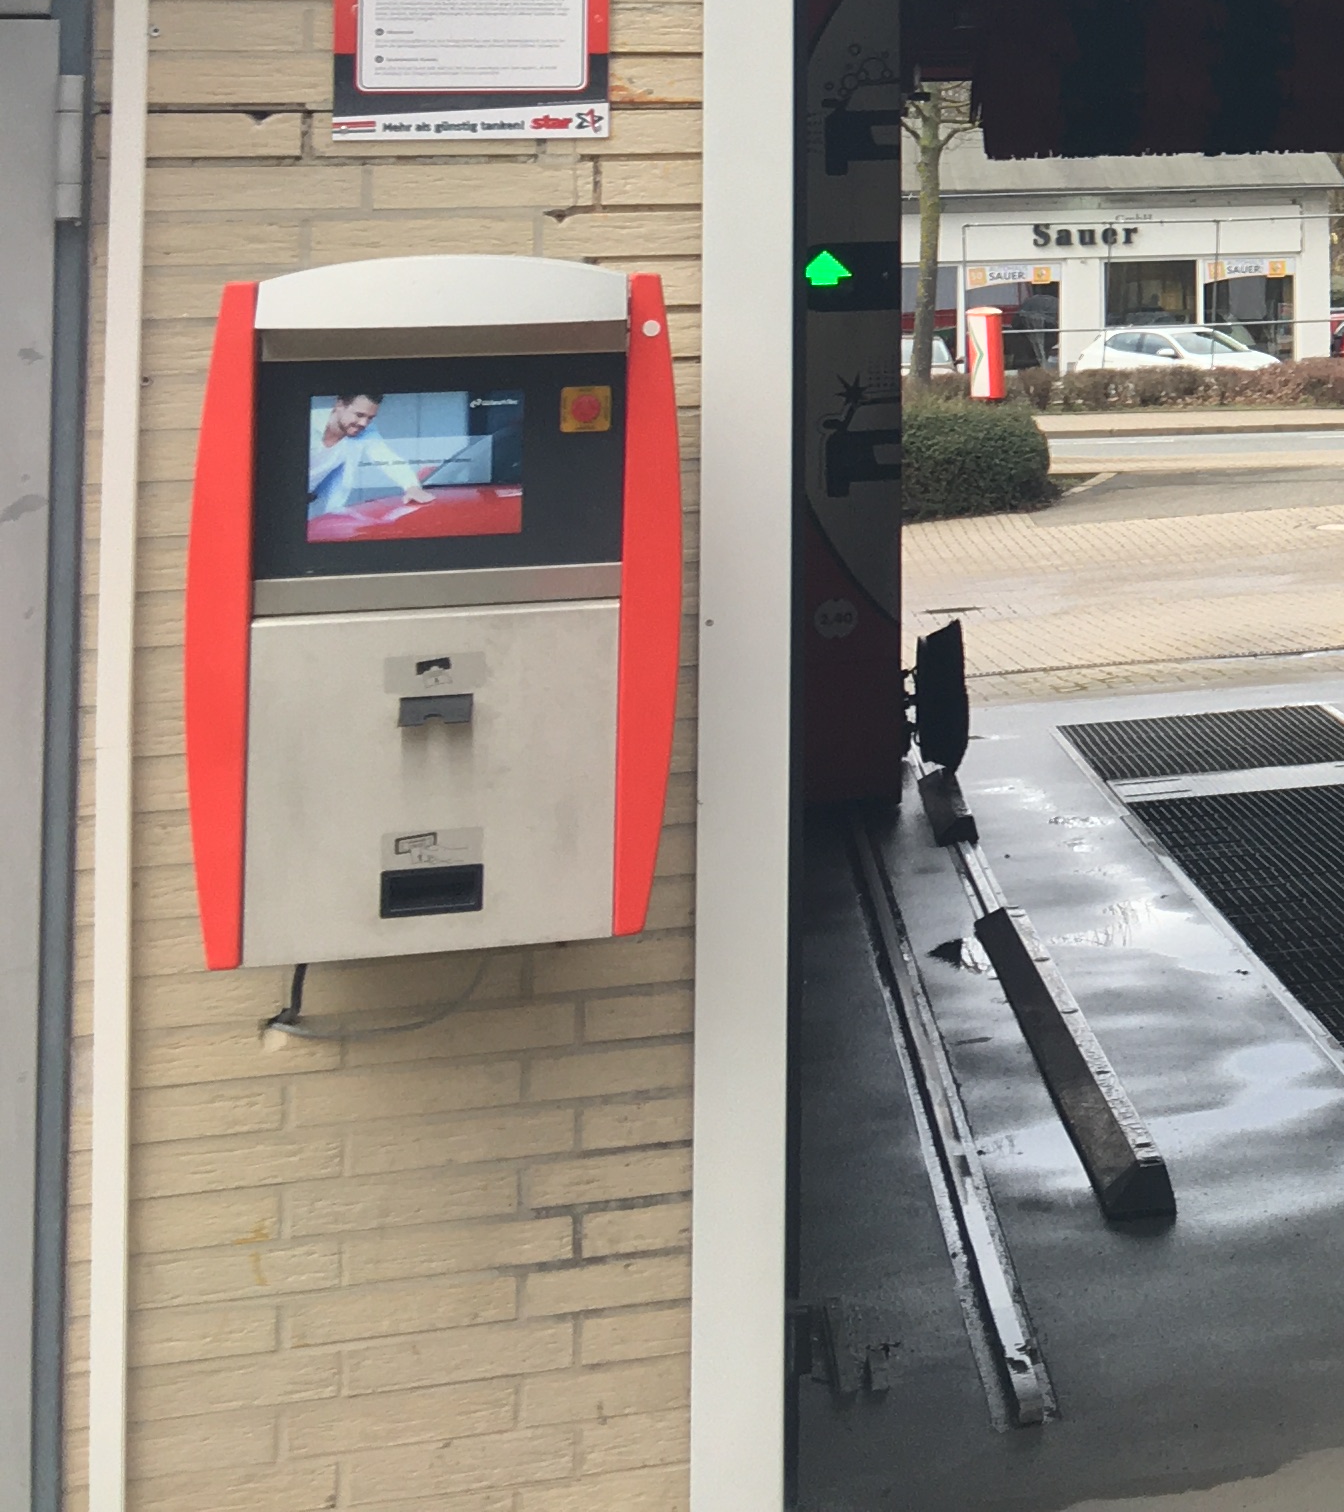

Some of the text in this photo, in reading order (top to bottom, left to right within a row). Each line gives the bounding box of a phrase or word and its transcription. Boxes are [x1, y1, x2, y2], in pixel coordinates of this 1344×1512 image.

[382, 120, 525, 133] Mehr als günstig tanken!
[530, 114, 573, 130] star
[1032, 223, 1138, 247] Sauer
[988, 271, 1025, 281] SAUER
